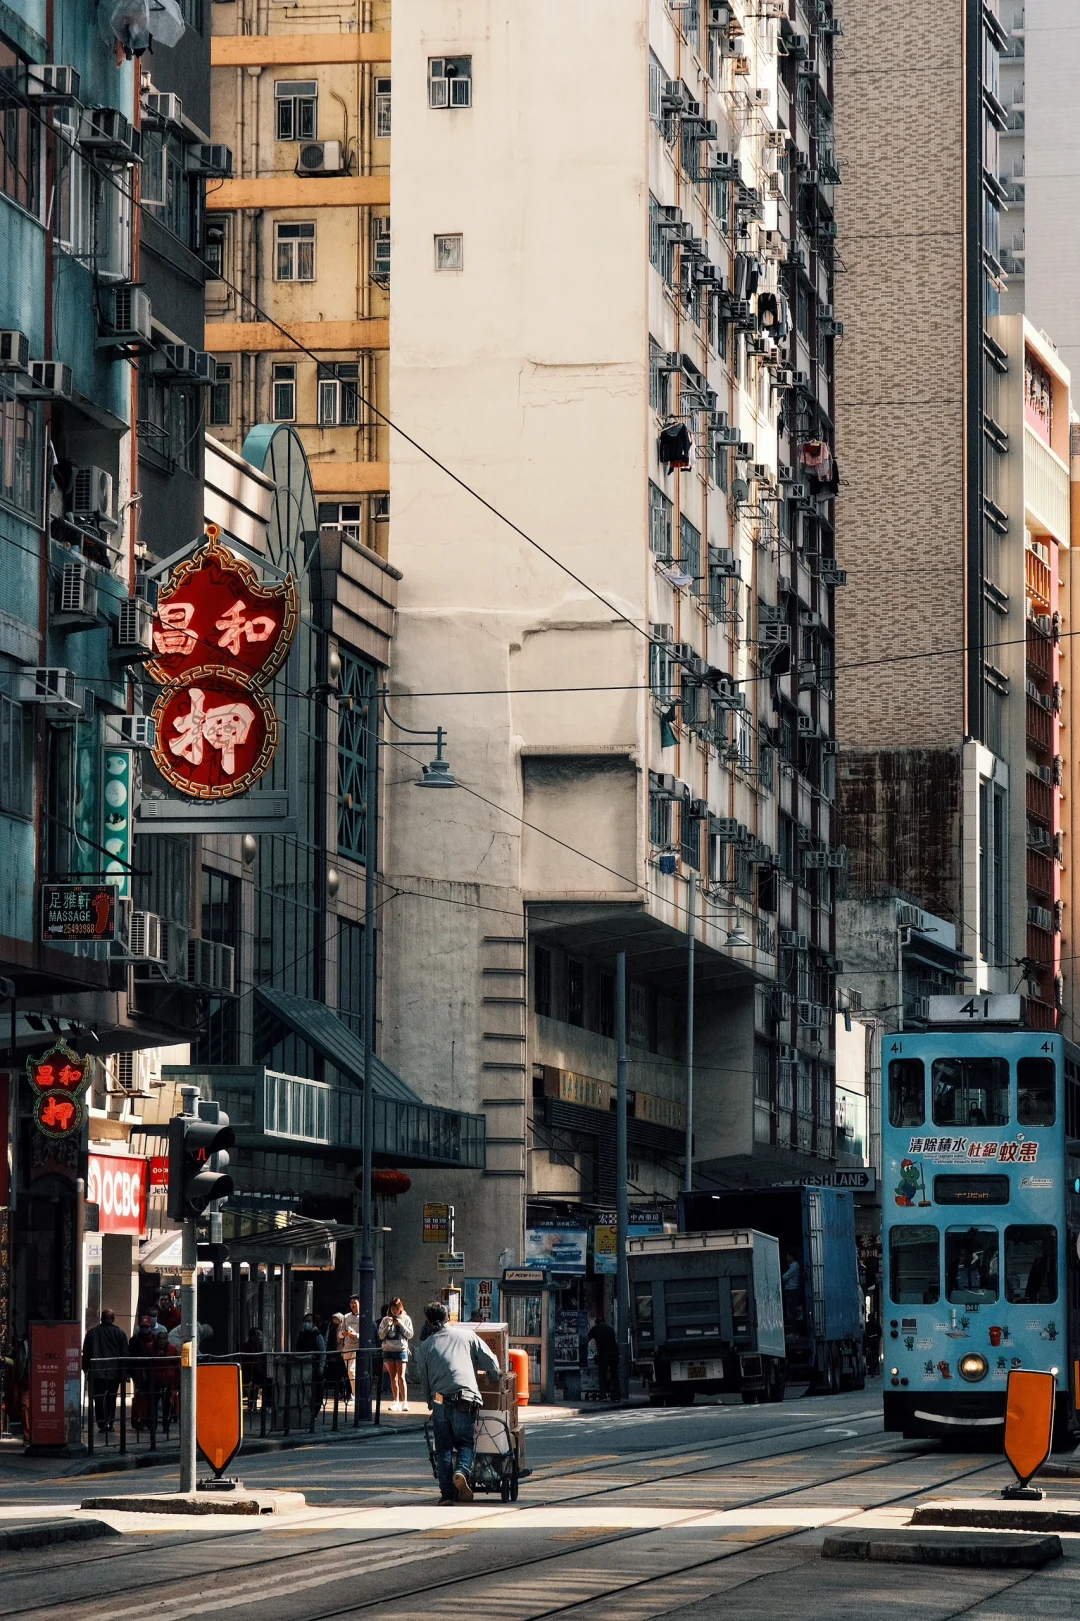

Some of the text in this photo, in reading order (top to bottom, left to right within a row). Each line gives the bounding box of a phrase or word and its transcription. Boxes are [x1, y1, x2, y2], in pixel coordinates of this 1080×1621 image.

[167, 687, 256, 776] 押
[48, 891, 92, 910] 足雅軒
[48, 910, 91, 922] MASSAGE
[63, 923, 95, 934] 25493988
[959, 997, 989, 1018] 41
[890, 1041, 903, 1053] 41
[1040, 1041, 1054, 1053] 41
[41, 1096, 76, 1130] 押
[908, 1136, 1039, 1162] 清除積水 杜絕蚊患
[833, 1173, 865, 1186] LANE
[102, 1169, 141, 1218] OCBC
